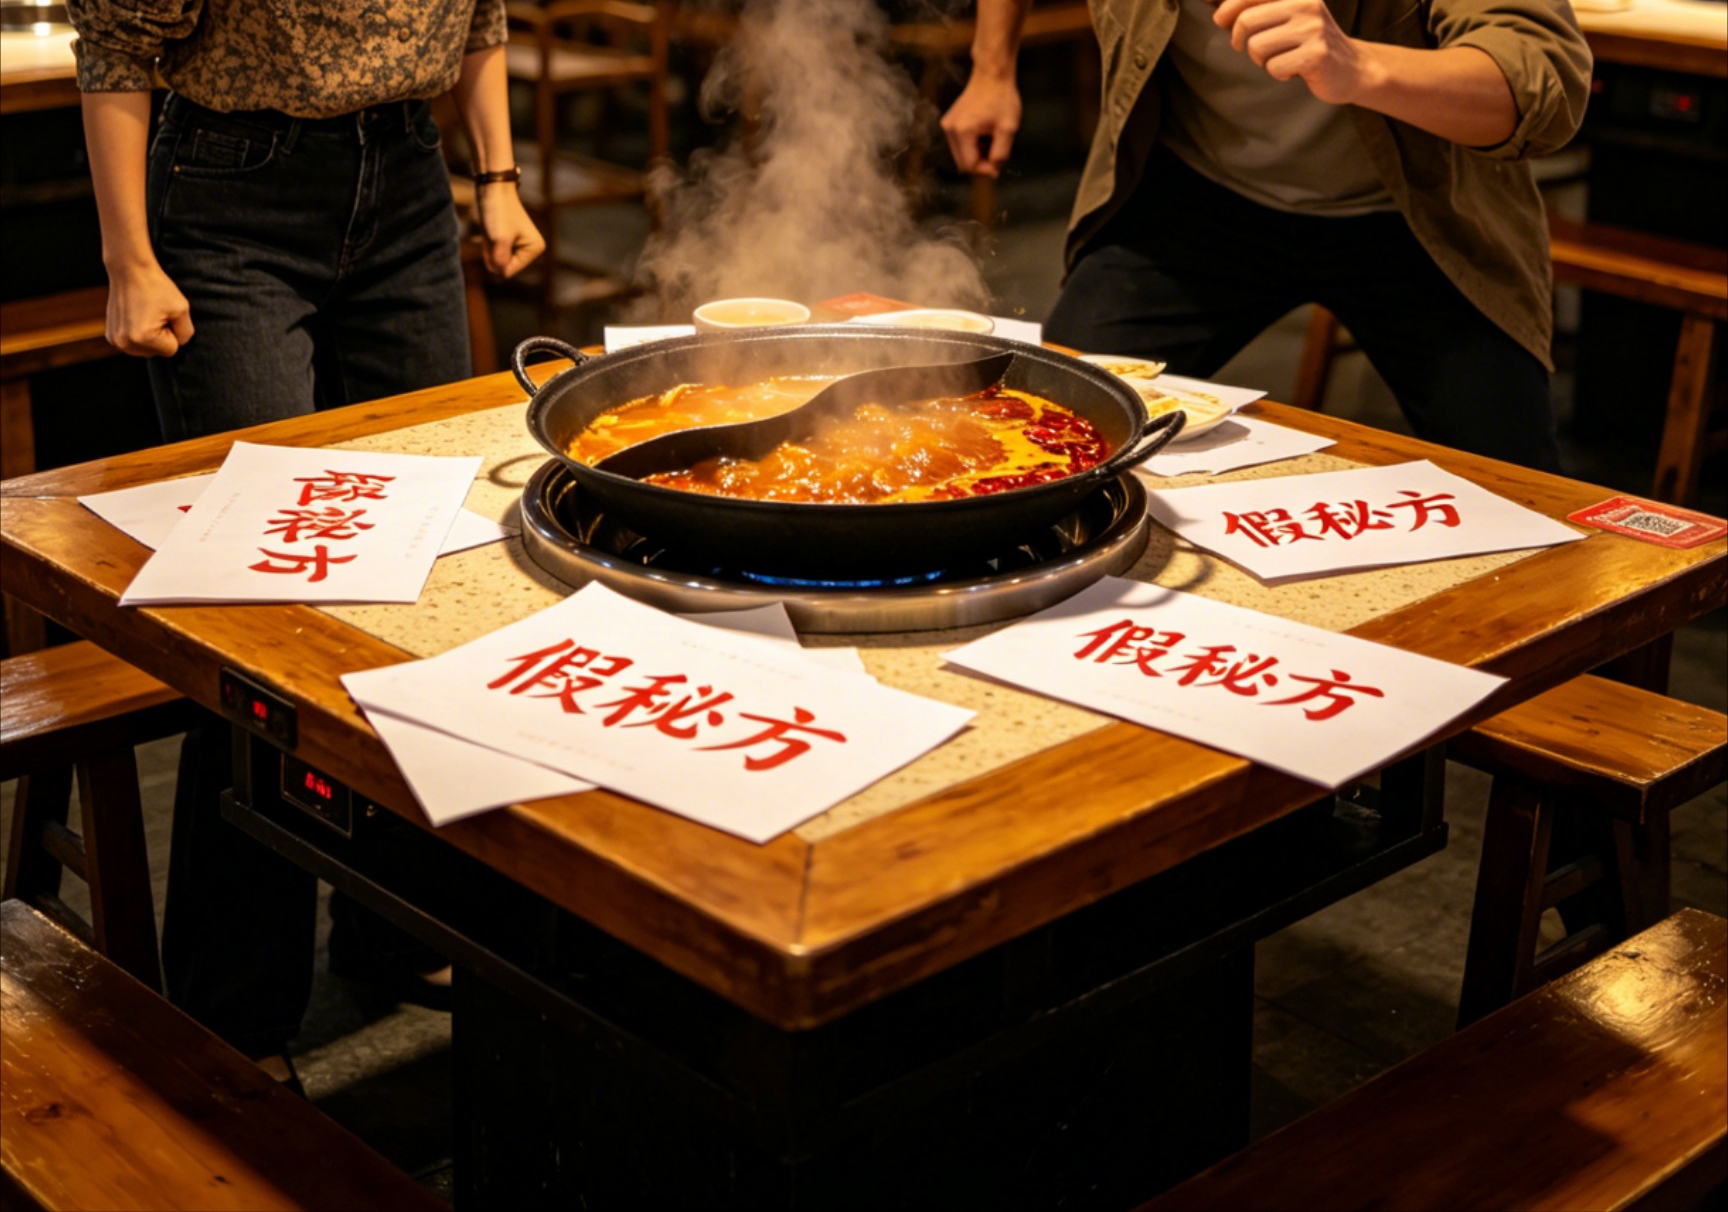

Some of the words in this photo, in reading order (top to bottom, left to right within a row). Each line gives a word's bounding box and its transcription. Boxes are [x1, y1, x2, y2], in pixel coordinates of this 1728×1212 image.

[1222, 490, 1462, 548] 假秘方
[487, 638, 848, 771] 假秘方
[1073, 619, 1385, 721] 假秘方
